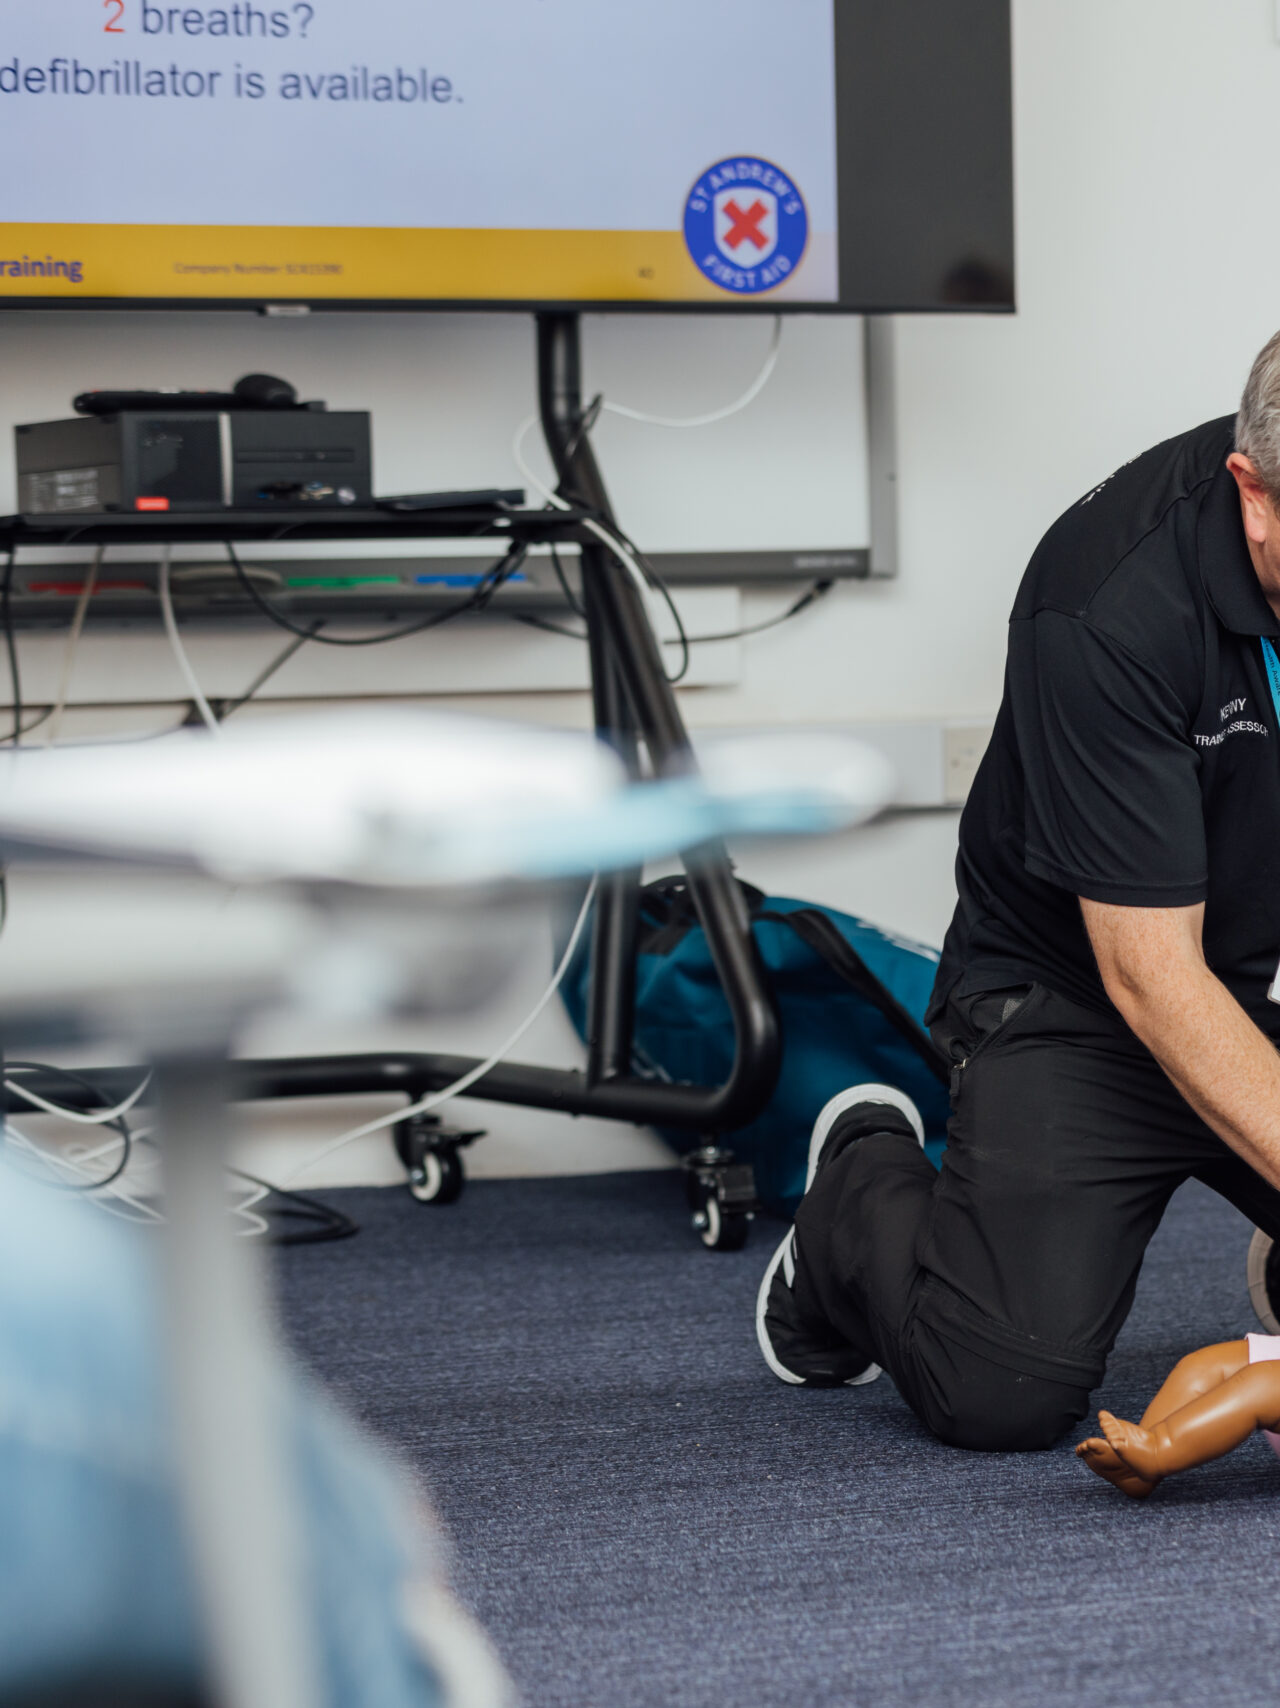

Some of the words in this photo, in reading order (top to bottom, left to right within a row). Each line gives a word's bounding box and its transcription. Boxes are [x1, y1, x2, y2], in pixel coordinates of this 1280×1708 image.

[103, 0, 125, 32] 2
[142, 0, 314, 38] breaths?
[0, 57, 222, 97] defibrillator
[234, 62, 265, 98] is
[281, 66, 463, 103] available.
[690, 186, 711, 213] ST
[703, 254, 755, 288] FIRST
[761, 255, 791, 285] AID
